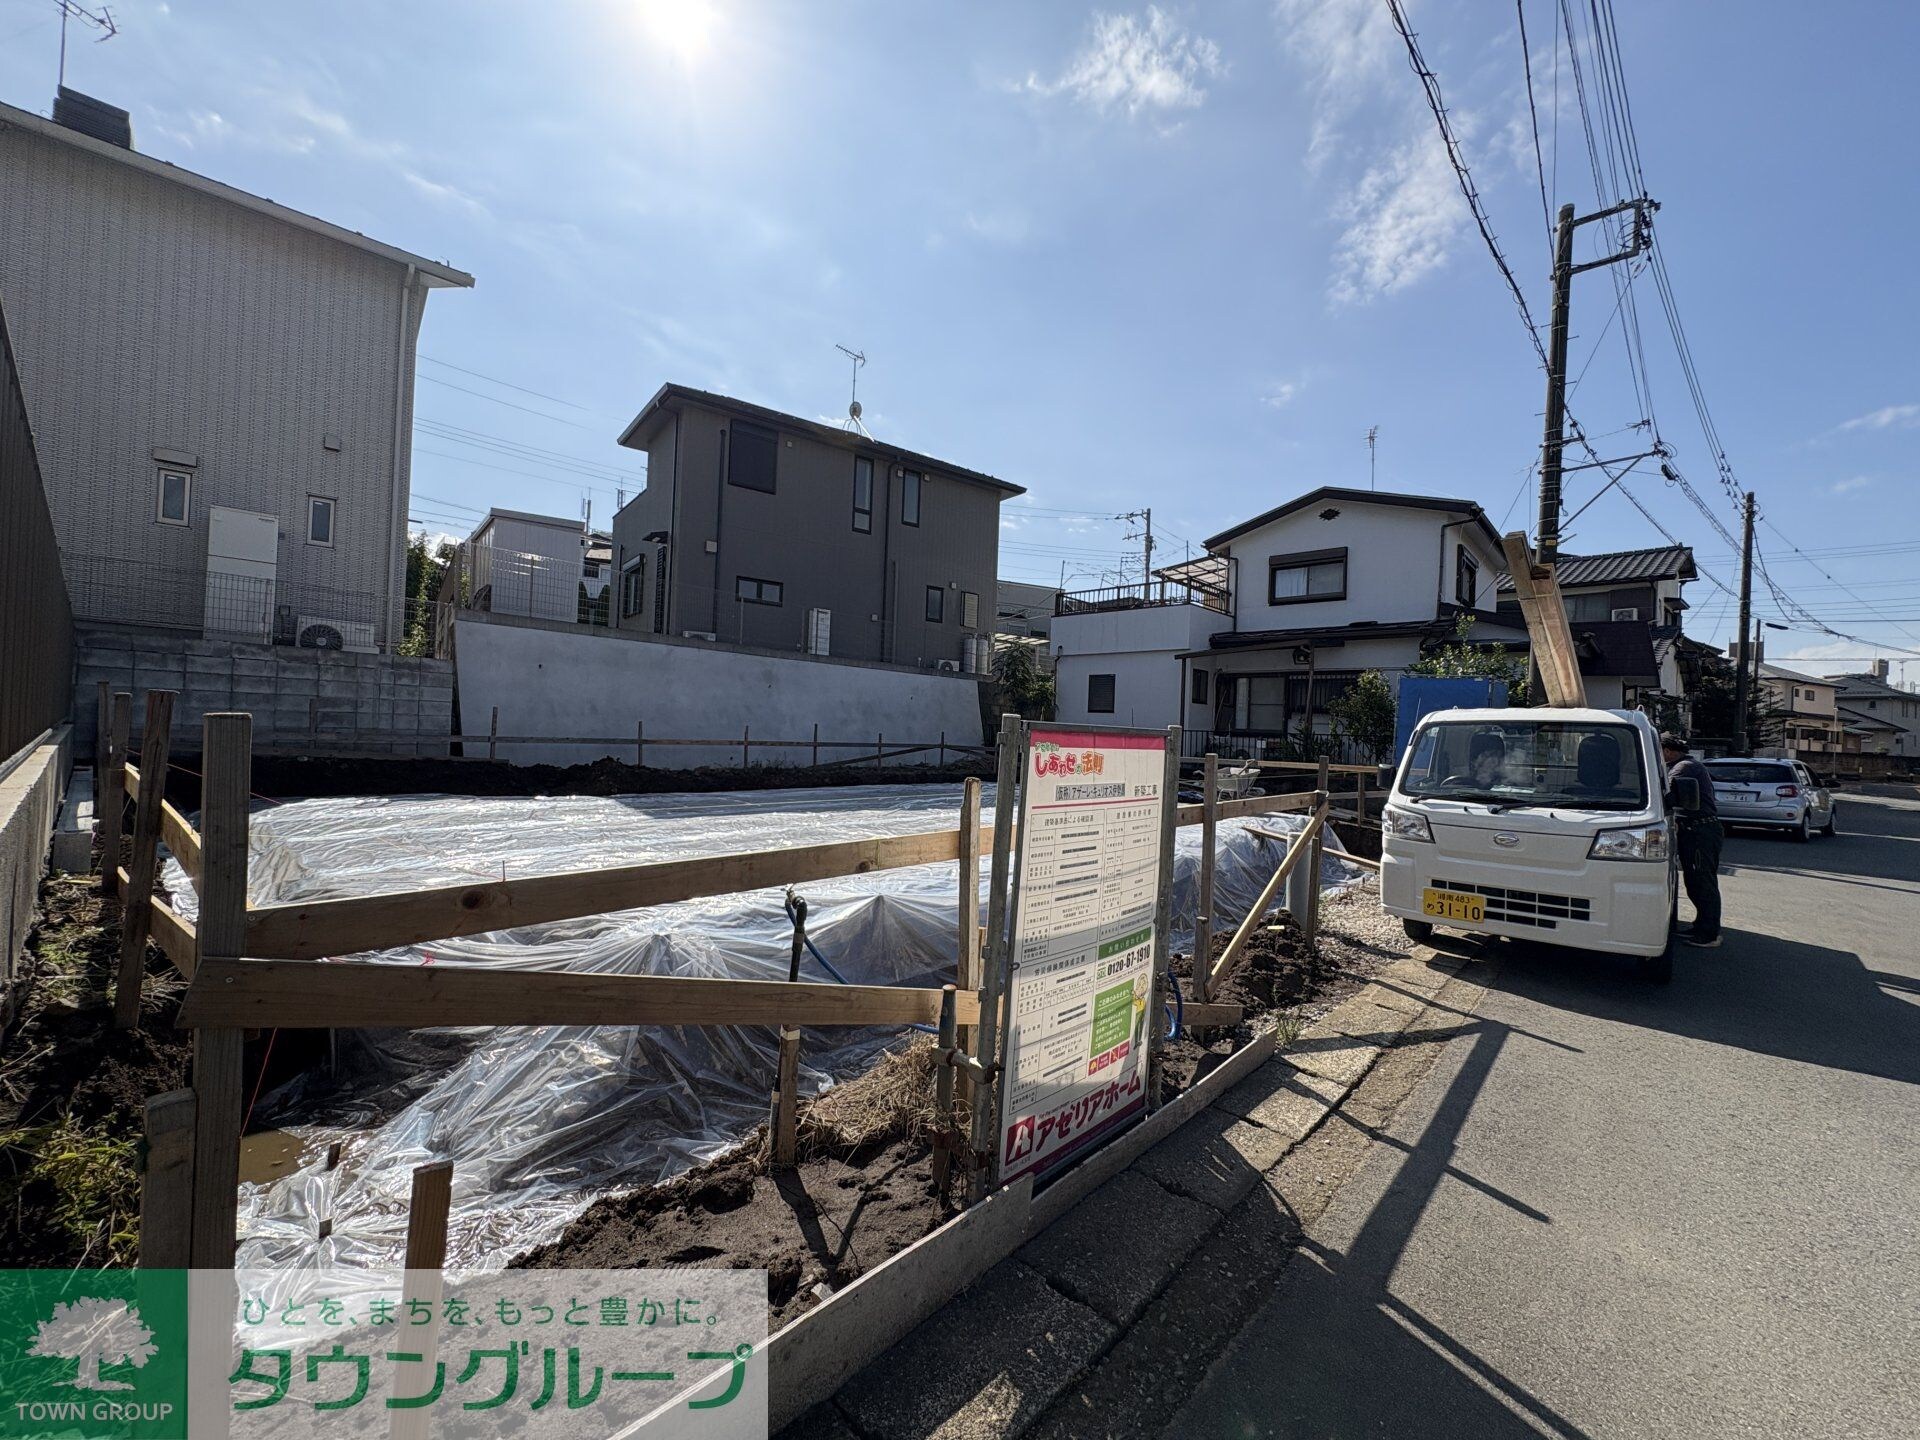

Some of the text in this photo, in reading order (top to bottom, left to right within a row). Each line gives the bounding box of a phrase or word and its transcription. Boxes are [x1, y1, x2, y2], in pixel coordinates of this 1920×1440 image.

[1436, 901, 1480, 920] 31-10
[1455, 895, 1470, 904] 483
[1107, 944, 1151, 976] 0120-67-1910
[1036, 1070, 1140, 1152] アゼリアホーム
